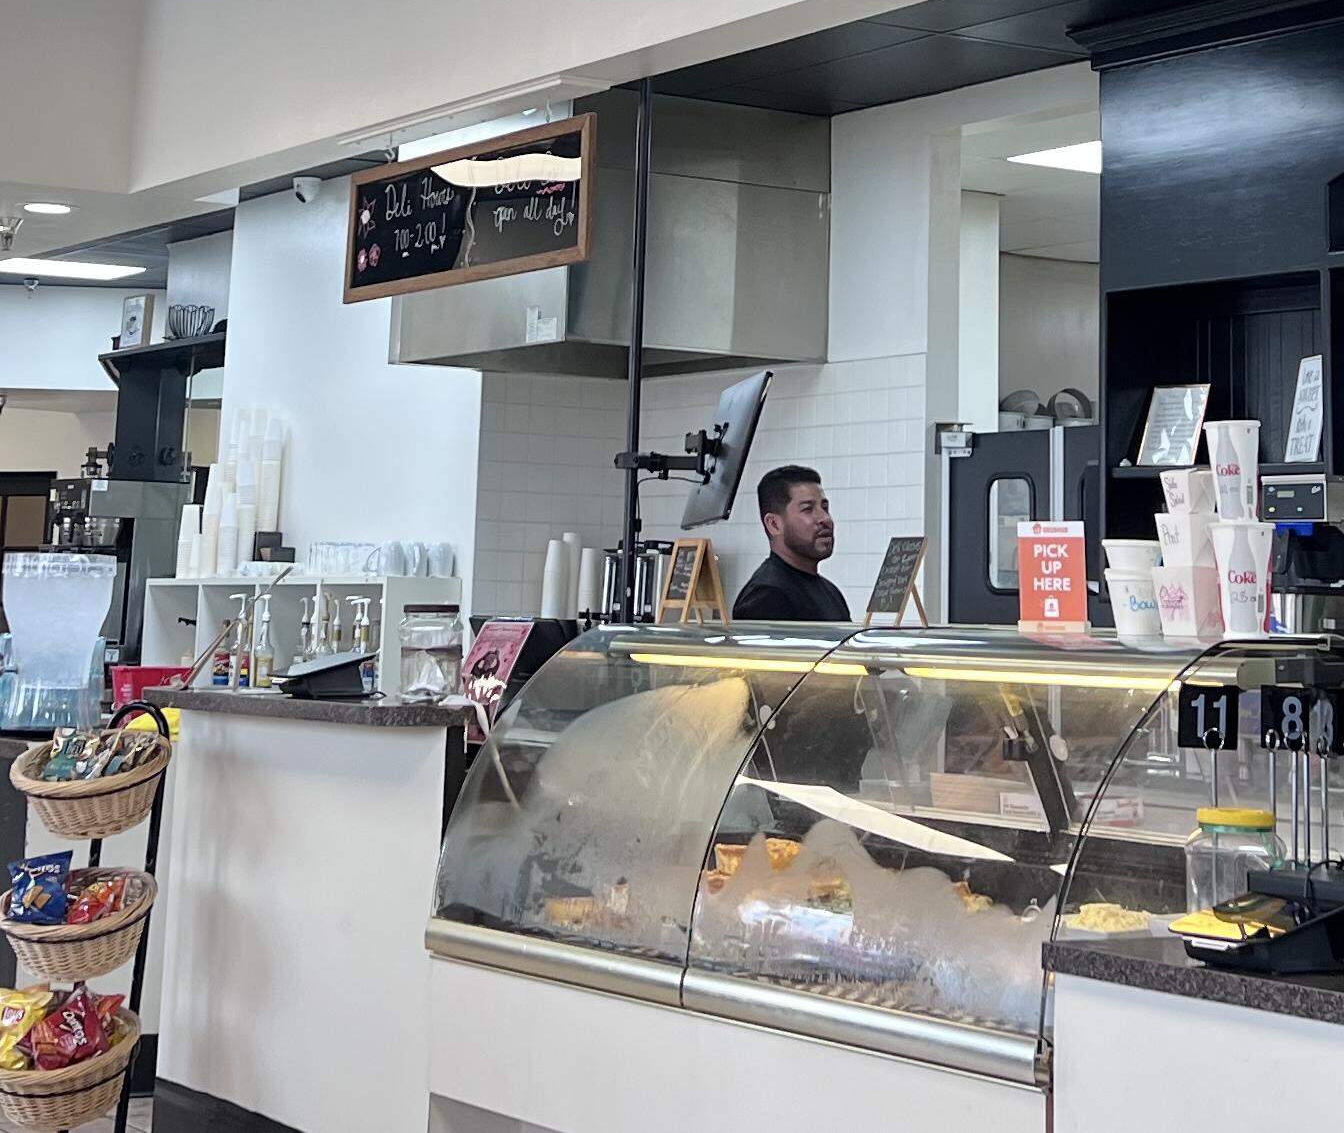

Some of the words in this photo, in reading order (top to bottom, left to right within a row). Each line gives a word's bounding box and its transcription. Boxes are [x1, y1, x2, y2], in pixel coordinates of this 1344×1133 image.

[384, 184, 413, 221] Deli
[1215, 463, 1241, 477] Coke
[1033, 543, 1069, 558] PICK
[1041, 560, 1063, 575] UP
[1033, 577, 1072, 592] HERE
[1227, 569, 1257, 585] Coke
[1191, 693, 1228, 740] 11
[1281, 695, 1304, 741] 8
